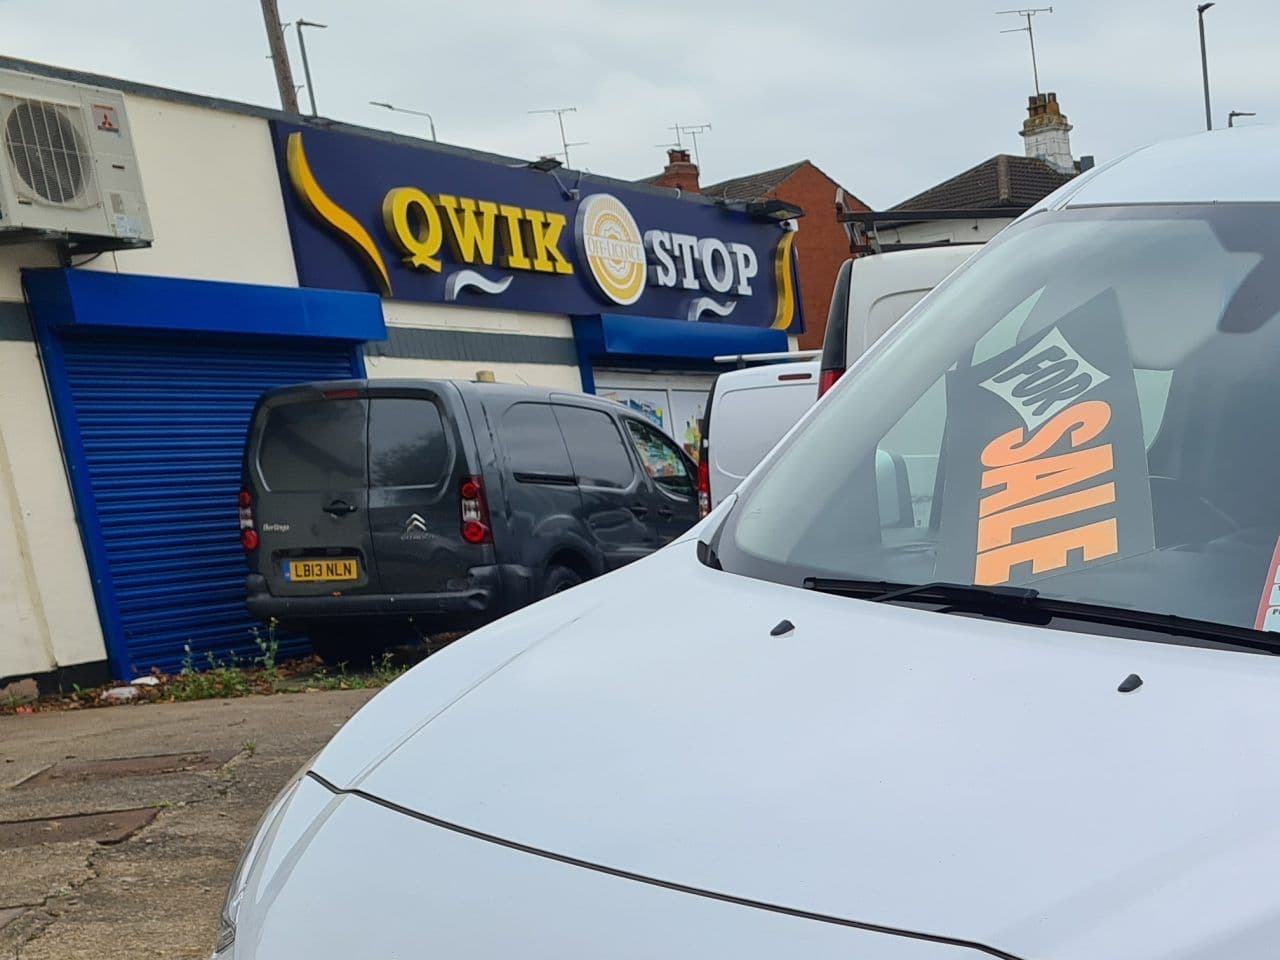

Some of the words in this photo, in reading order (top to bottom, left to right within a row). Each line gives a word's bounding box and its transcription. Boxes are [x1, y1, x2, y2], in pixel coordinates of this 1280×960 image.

[384, 187, 574, 274] QWIK
[644, 230, 759, 296] STOP
[992, 345, 1093, 417] FOR
[974, 400, 1119, 586] SALE
[295, 563, 323, 578] LB13
[326, 562, 352, 577] NLN
